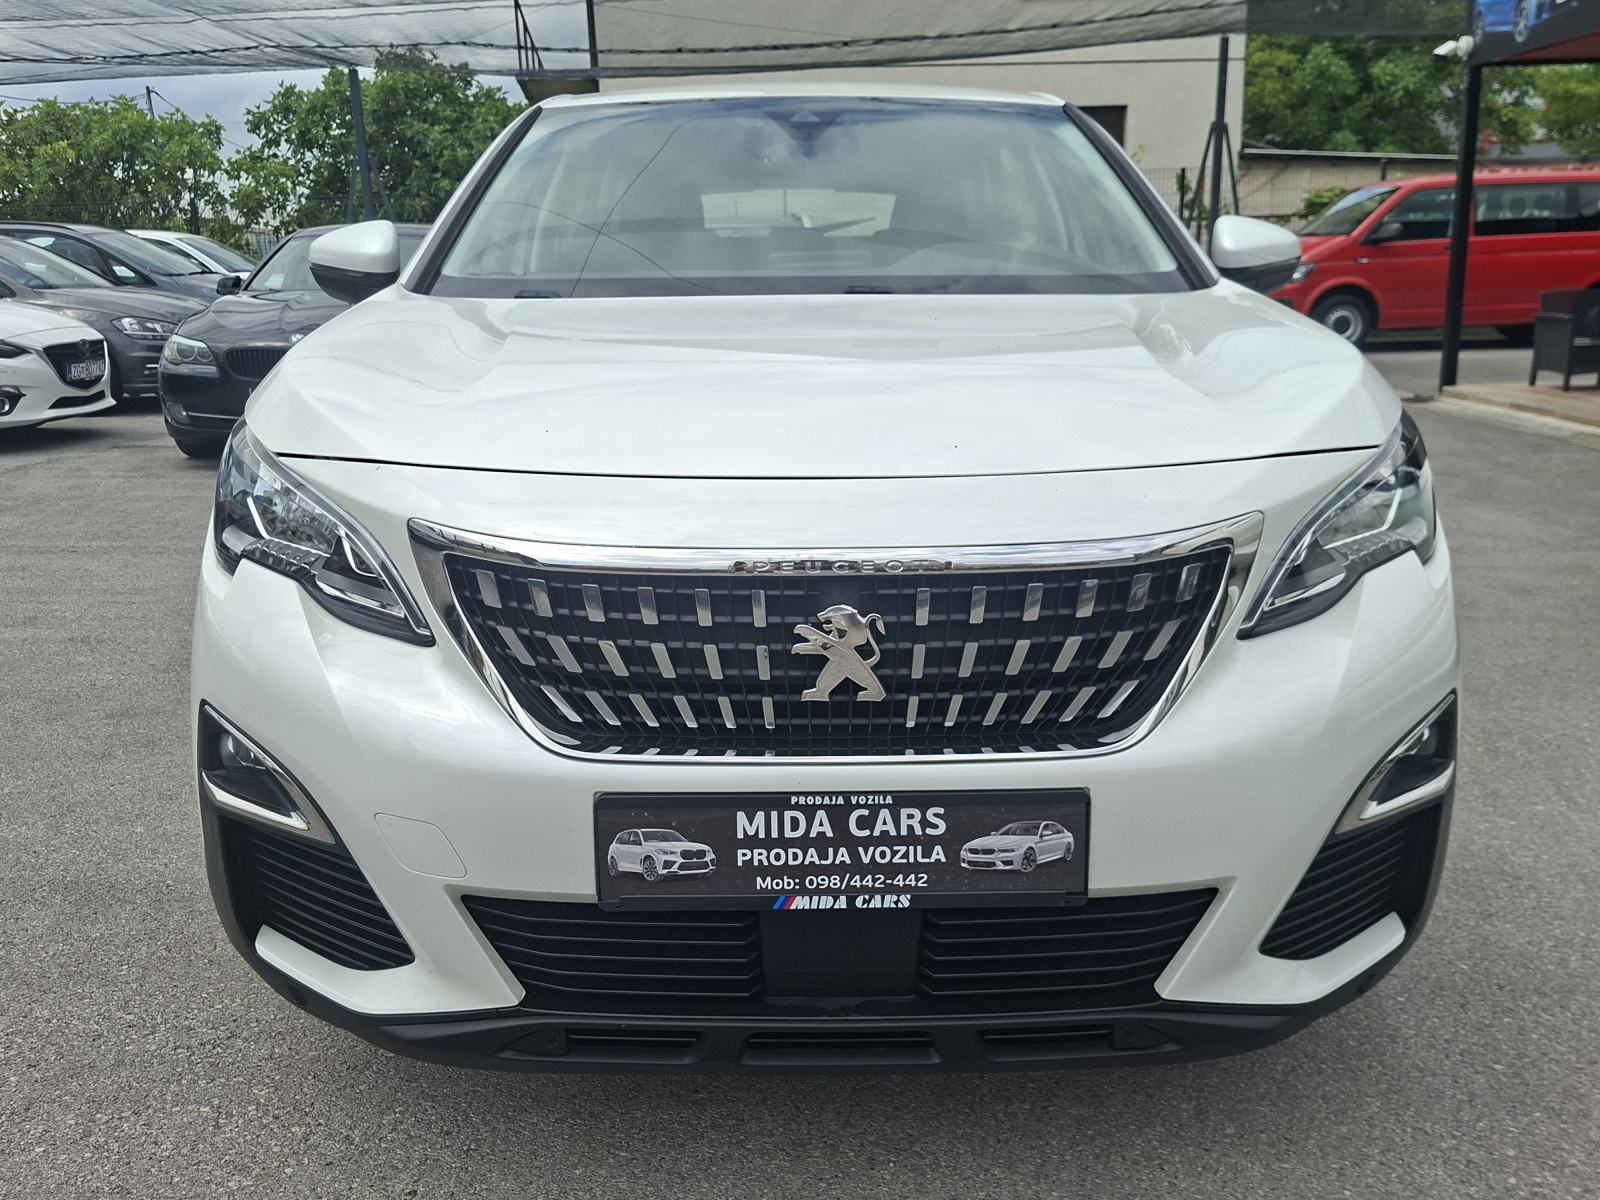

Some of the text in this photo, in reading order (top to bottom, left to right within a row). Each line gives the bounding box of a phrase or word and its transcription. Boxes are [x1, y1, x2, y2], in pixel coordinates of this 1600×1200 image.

[752, 560, 931, 574] PEUGEOT
[790, 795, 893, 805] PRODAJA VOZILA
[736, 806, 947, 839] MIDA CARS
[736, 845, 947, 867] PRODAJA VOZILA
[756, 873, 929, 890] Mob: 098/442-442
[790, 894, 911, 910] MIDA CARS
